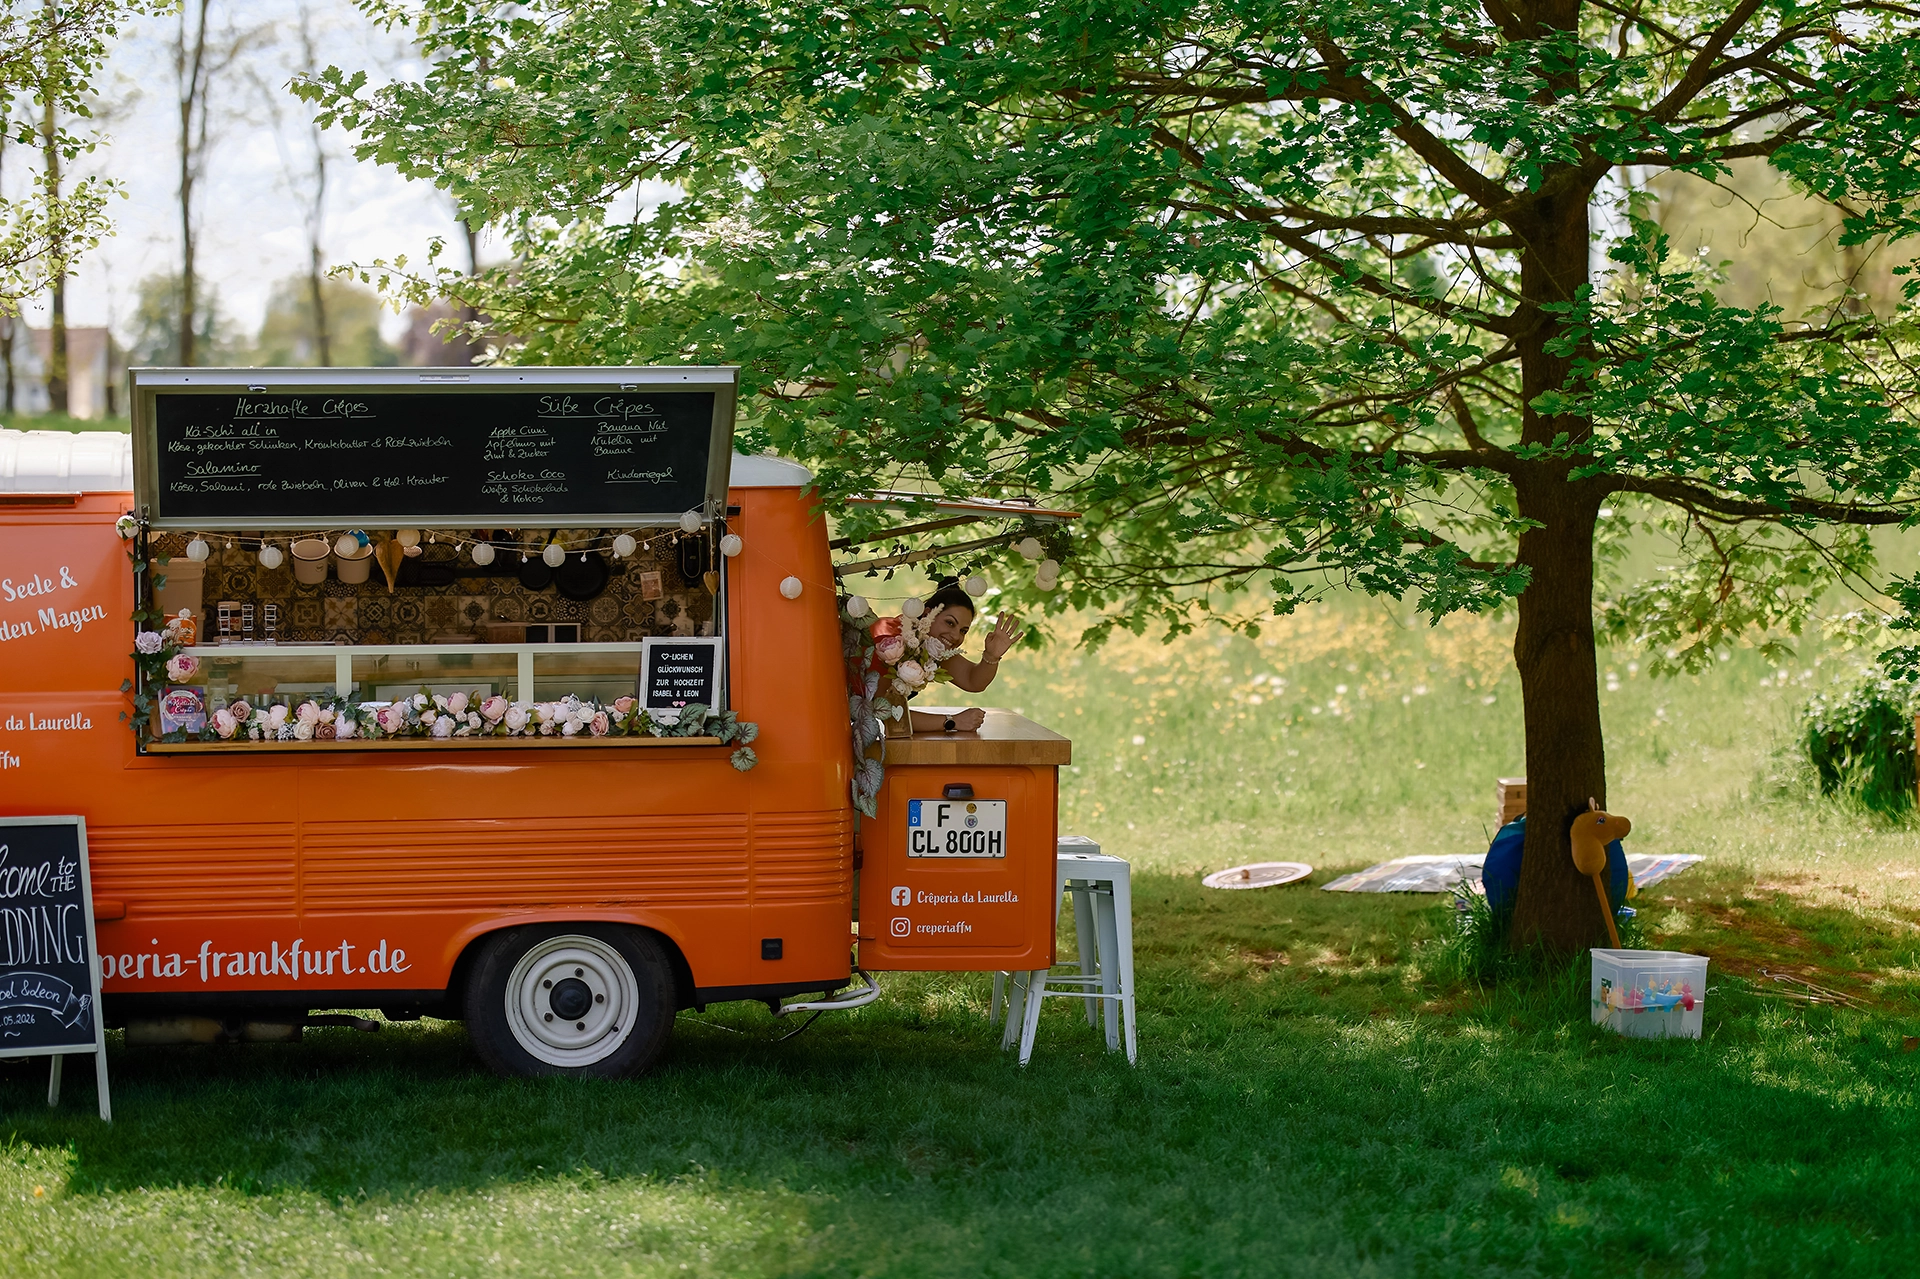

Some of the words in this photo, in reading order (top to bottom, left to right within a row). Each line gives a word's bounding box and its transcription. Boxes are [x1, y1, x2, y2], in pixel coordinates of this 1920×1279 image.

[235, 397, 309, 418] Herzhafte
[537, 395, 579, 416] Süße
[593, 396, 655, 421] Crêpes
[241, 425, 258, 436] all
[265, 426, 277, 435] in
[490, 427, 516, 438] Apple
[597, 421, 642, 433] Banana
[648, 420, 669, 431] Nut
[197, 442, 246, 455] gekochter
[371, 438, 382, 448] &
[485, 438, 536, 450] Apfelmus
[540, 437, 556, 447] mit
[590, 435, 633, 445] Nutella
[640, 434, 658, 443] mit
[483, 449, 505, 461] Zimt
[508, 449, 516, 458] &
[517, 448, 550, 459] Zucker
[593, 446, 635, 457] Banane
[186, 461, 261, 475] Salamino
[487, 469, 535, 481] Schoko
[539, 468, 566, 479] Coco
[607, 466, 674, 485] Kinderriegel
[257, 480, 278, 490] rote
[333, 479, 369, 490] Oliven
[372, 476, 381, 487] &
[406, 473, 450, 486] Kräuter
[481, 483, 508, 496] Weiße
[499, 494, 509, 504] &
[512, 494, 544, 503] Kokos
[2, 573, 57, 602] Seele
[59, 566, 79, 589] &
[0, 620, 38, 642] den
[37, 604, 108, 633] Magen
[657, 664, 703, 673] GLÜCKWUNSCH
[5, 715, 26, 731] da
[29, 711, 94, 731] Laurella
[911, 816, 918, 824] D
[937, 804, 951, 827] F
[912, 830, 940, 854] CL
[945, 830, 1002, 854] 800H
[58, 855, 77, 875] to
[50, 874, 76, 892] THE
[917, 890, 959, 906] Crêperia
[962, 892, 975, 903] da
[977, 890, 1019, 904] Laurella
